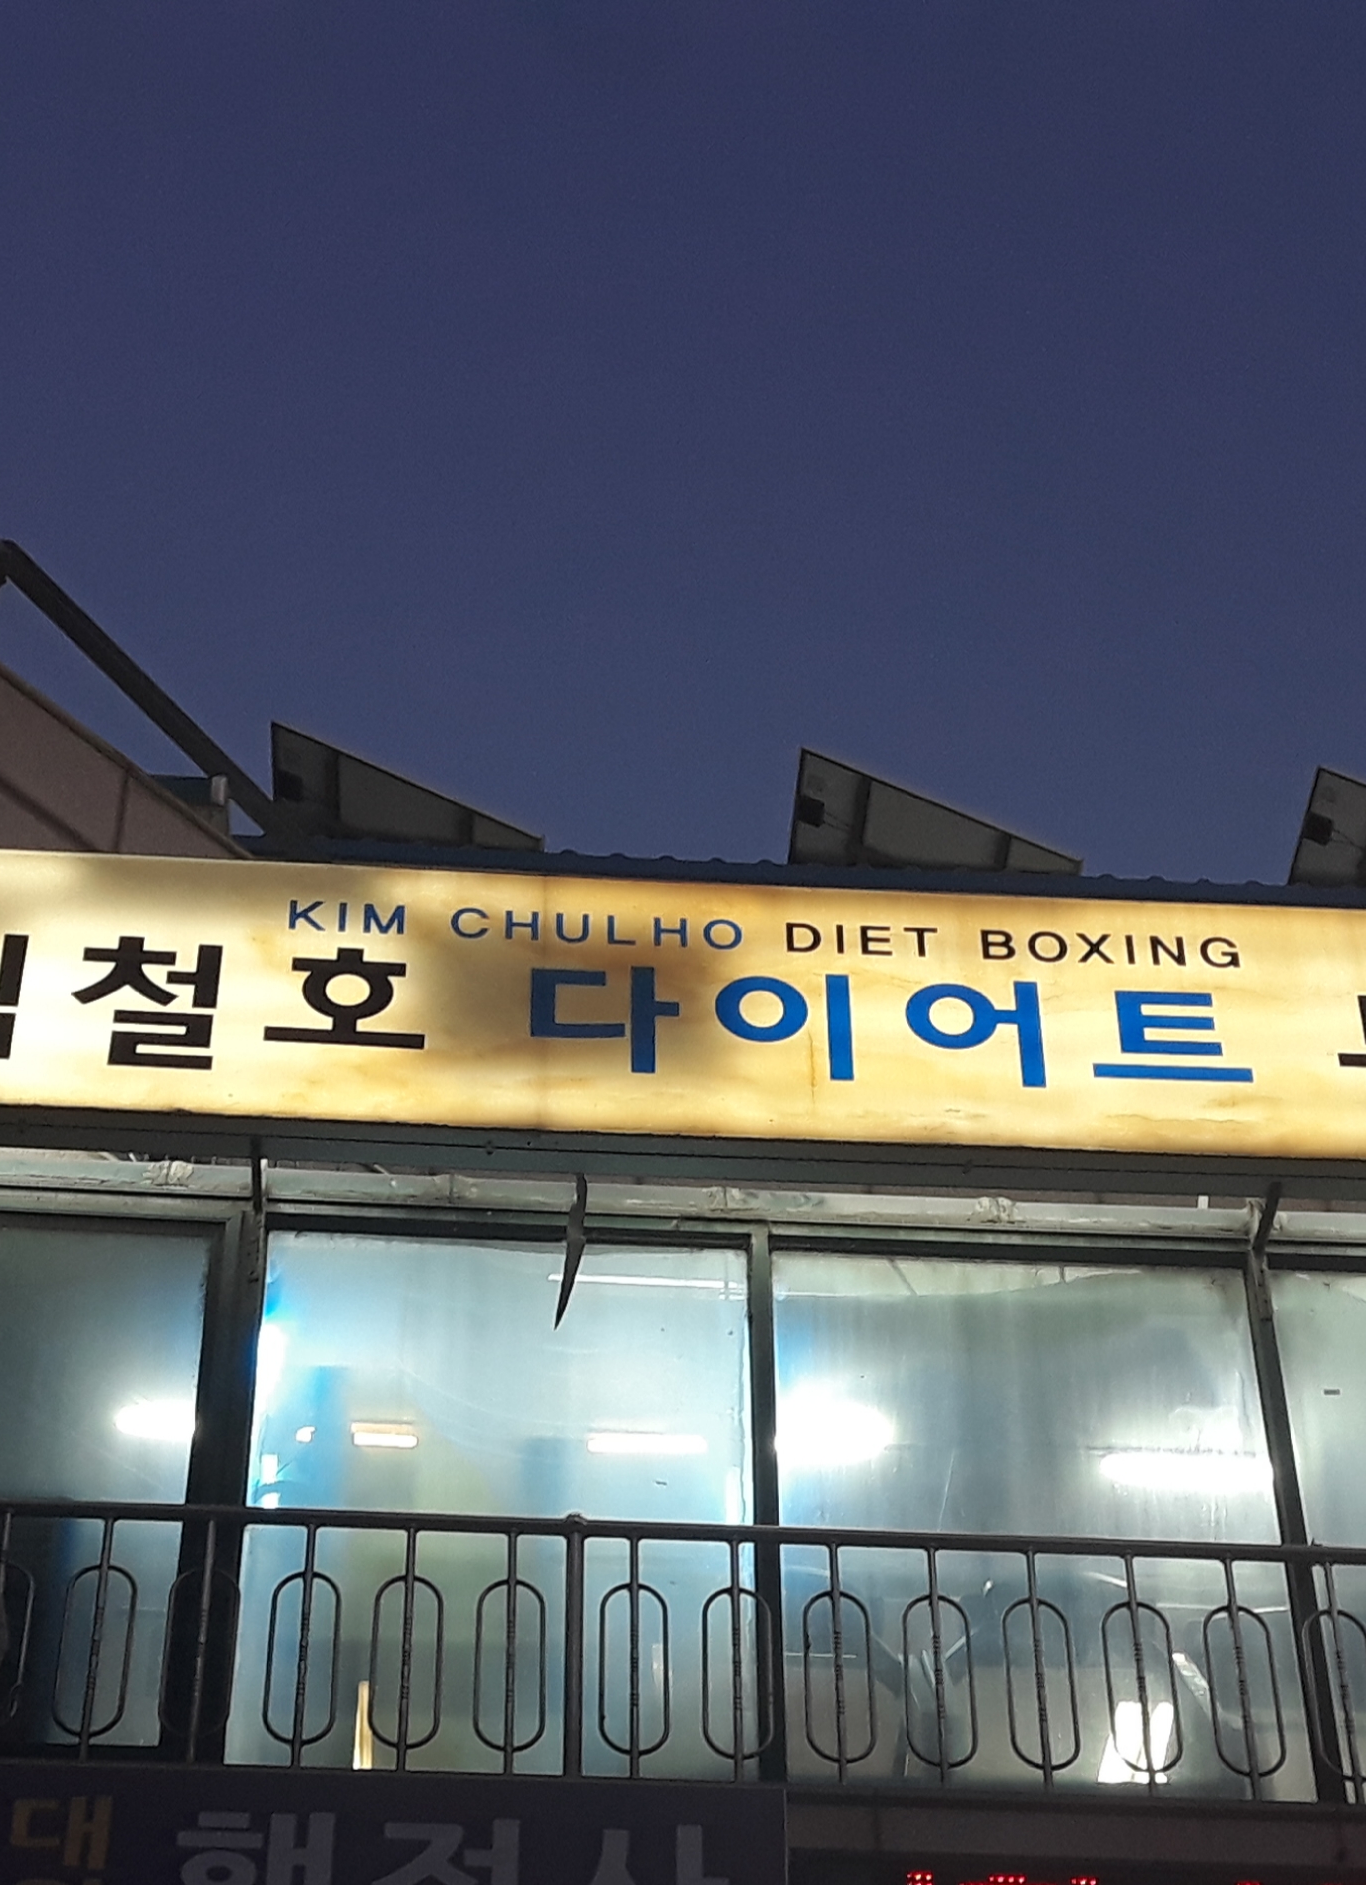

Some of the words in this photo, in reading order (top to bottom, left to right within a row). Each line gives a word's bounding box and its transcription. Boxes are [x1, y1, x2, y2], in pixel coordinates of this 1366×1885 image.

[288, 899, 408, 935] KIM
[450, 907, 744, 951] CHULHO
[785, 922, 939, 959] DIET
[981, 928, 1242, 970] BOXING
[529, 965, 1254, 1089] 다이어트
